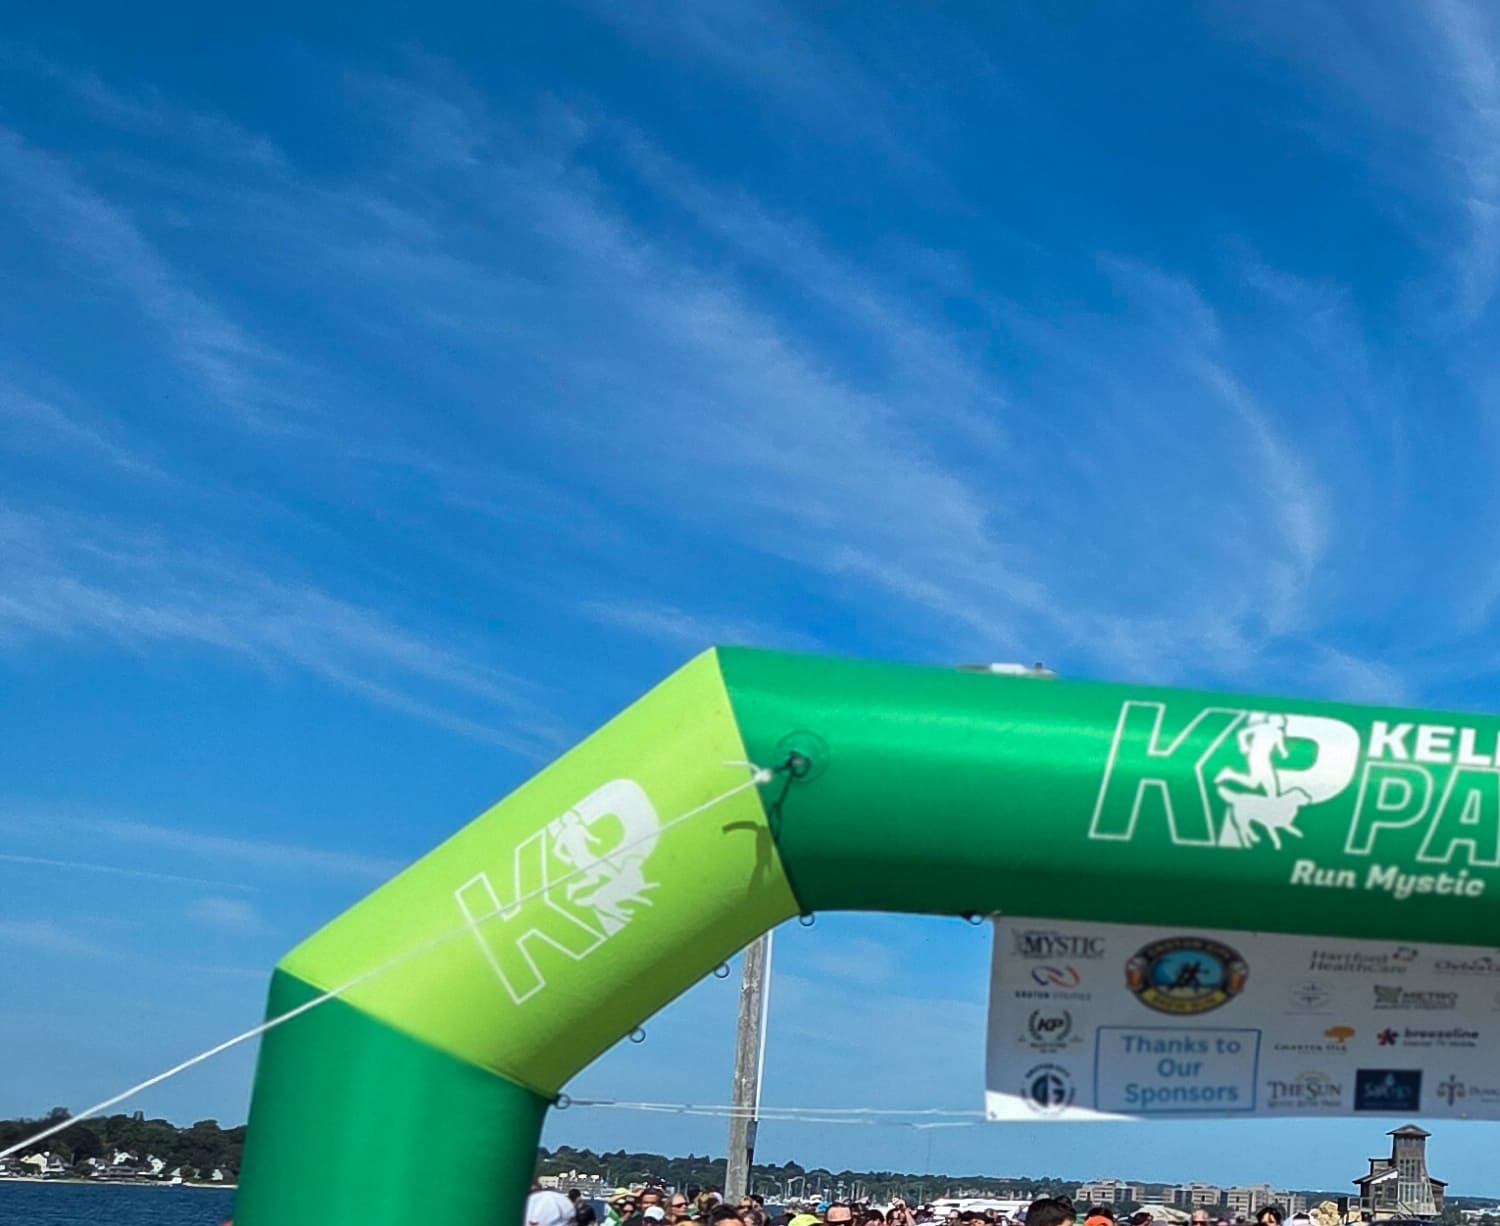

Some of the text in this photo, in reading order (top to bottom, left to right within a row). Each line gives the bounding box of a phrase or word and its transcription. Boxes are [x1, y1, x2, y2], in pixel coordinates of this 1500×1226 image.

[1290, 859, 1485, 900] Run Mystic
[1024, 935, 1106, 955] MYSTIC
[1121, 1035, 1242, 1055] Thanks to
[1157, 1058, 1204, 1078] Our
[1124, 1083, 1240, 1105] Sponsors
